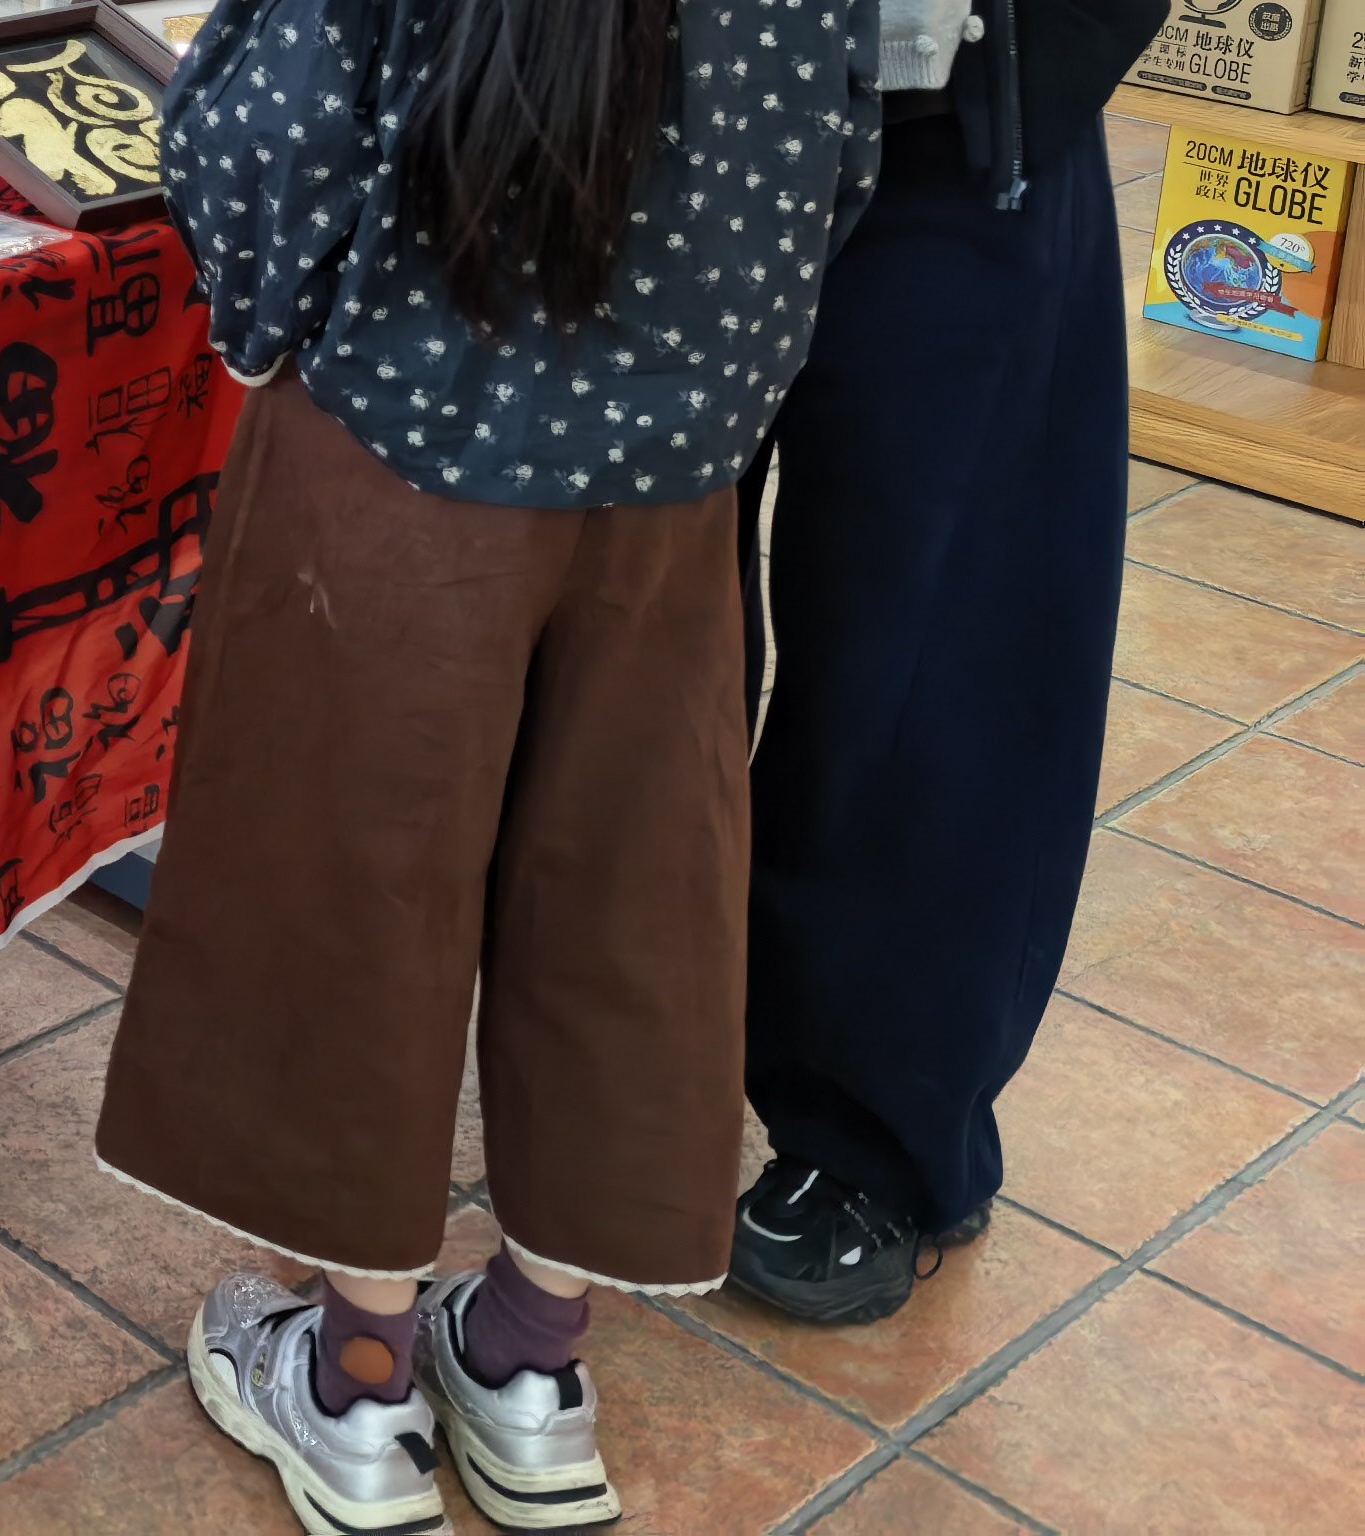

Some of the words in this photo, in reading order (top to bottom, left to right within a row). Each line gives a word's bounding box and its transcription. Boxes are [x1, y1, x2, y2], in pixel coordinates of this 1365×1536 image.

[1156, 25, 1190, 43] 0CM
[1193, 30, 1255, 59] 地球仪
[1189, 53, 1253, 85] GLOBE
[1186, 140, 1234, 167] 20CM
[1200, 170, 1229, 187] 世界
[1237, 149, 1331, 191] 地球仪
[1195, 186, 1227, 202] 政区
[1234, 176, 1327, 225] GLOBE
